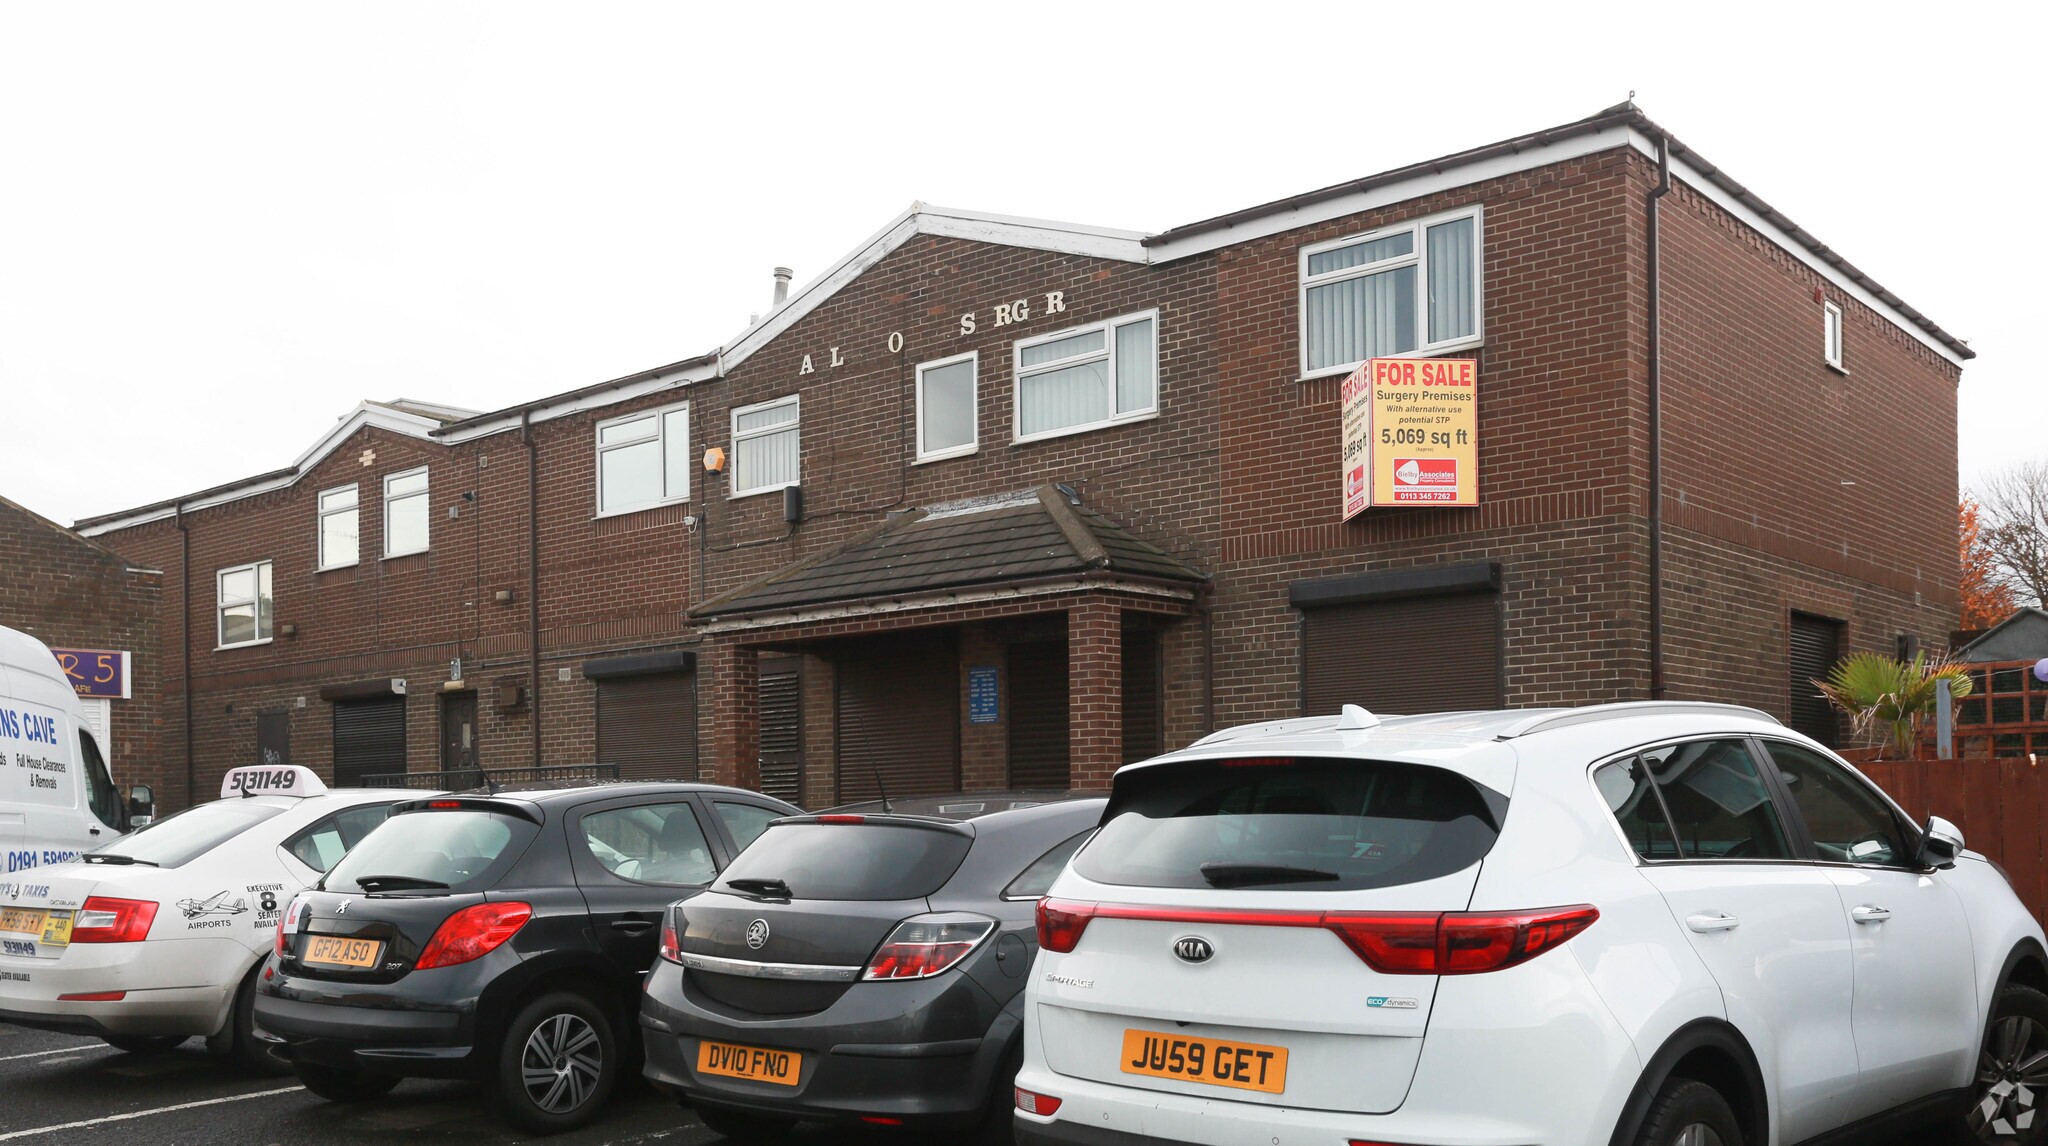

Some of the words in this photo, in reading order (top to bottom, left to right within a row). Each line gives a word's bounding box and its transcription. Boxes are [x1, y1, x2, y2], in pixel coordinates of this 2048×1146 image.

[961, 313, 976, 336] S
[994, 299, 1029, 328] RG
[1046, 291, 1066, 314] R
[800, 355, 814, 375] A
[830, 347, 844, 368] L
[888, 332, 904, 352] O
[1376, 363, 1416, 386] FOR
[1422, 364, 1471, 386] SALE
[1376, 390, 1419, 402] Surgery
[1422, 391, 1472, 401] Premises
[1405, 405, 1446, 413] alternative
[1398, 416, 1433, 425] potential
[1382, 428, 1425, 447] 5,069
[1431, 432, 1450, 448] sq
[1456, 429, 1467, 444] ft
[95, 655, 114, 682] 5
[23, 712, 56, 745] CAVE
[16, 753, 26, 768] Full
[26, 755, 42, 770] House
[43, 757, 66, 773] Clearances
[35, 774, 57, 789] Removals
[230, 770, 296, 790] 5131149
[8, 851, 37, 872] 0191
[22, 884, 50, 898] TAXIS
[246, 884, 284, 892] EXECUTIVE
[260, 891, 277, 911] 8
[188, 919, 232, 930] AIRPORTS
[254, 920, 280, 929] AVAILA
[3, 940, 36, 956] 5131149
[314, 939, 342, 958] GF12
[342, 940, 370, 961] ASO
[1179, 941, 1206, 957] KIA
[1046, 972, 1094, 988] SPORTAGE
[708, 1045, 747, 1072] DV10
[751, 1052, 789, 1078] FNO
[1132, 1036, 1205, 1076] JU59
[1213, 1046, 1274, 1085] GET
